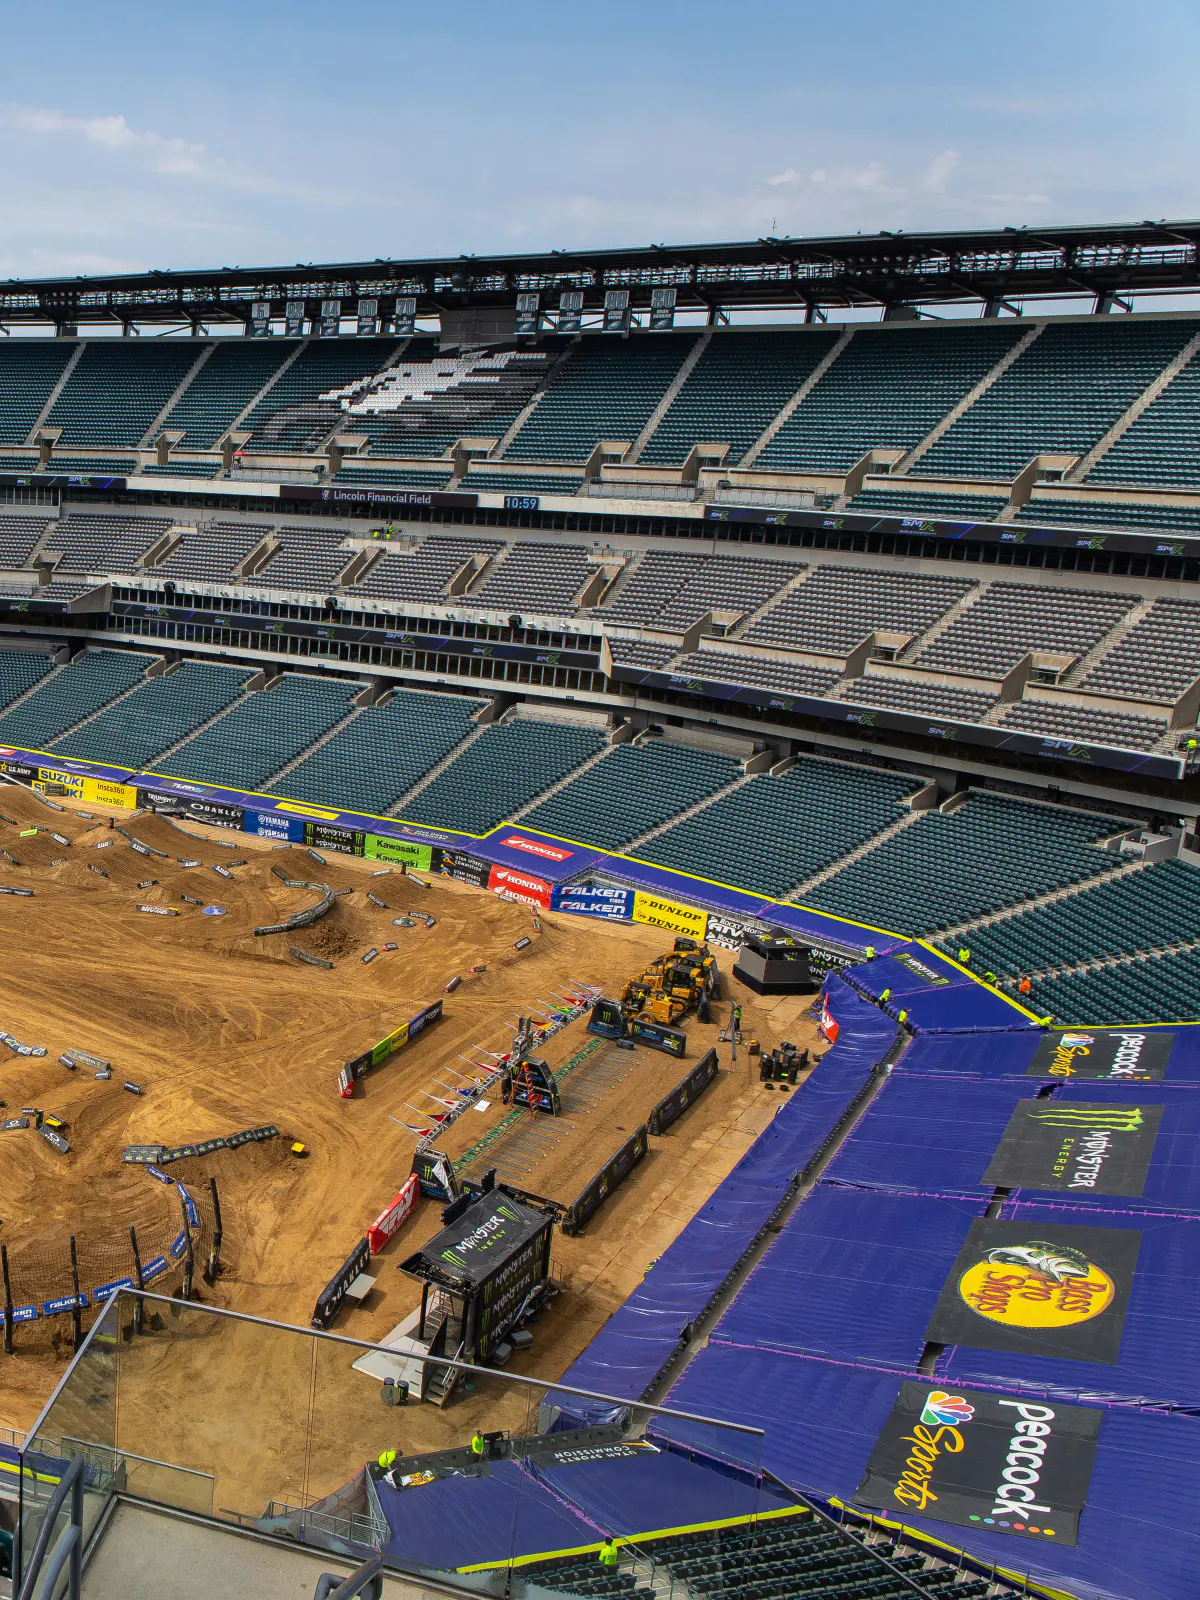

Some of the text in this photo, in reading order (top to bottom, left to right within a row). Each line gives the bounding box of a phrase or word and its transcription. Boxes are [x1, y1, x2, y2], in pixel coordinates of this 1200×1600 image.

[562, 293, 581, 309] 40
[607, 292, 628, 309] 99
[653, 290, 675, 308] 20
[333, 490, 432, 505] Lincoln Financial Field
[505, 496, 537, 510] 10:59
[41, 770, 85, 788] SUZUKI
[97, 783, 125, 795] Insta360
[96, 795, 124, 806] Insta360
[205, 806, 242, 818] OAKLEY
[265, 817, 289, 827] YAMAHA
[265, 829, 288, 839] YAMAHA
[316, 826, 352, 839] MONSTER
[377, 839, 419, 855] Kawasaki
[520, 841, 562, 859] HONDA
[507, 876, 543, 892] HONDA
[561, 886, 627, 898] FALKEN
[505, 889, 541, 907] HONDA
[560, 901, 626, 914] FALKEN
[649, 901, 702, 921] DUNLOP
[648, 916, 699, 937] DUNLOP
[720, 918, 742, 930] ROCKY
[812, 948, 852, 966] ONSTER
[907, 958, 939, 980] MONSTER
[1048, 1045, 1091, 1077] Sports
[1109, 1033, 1147, 1075] peacock
[1052, 1137, 1075, 1178] ENERGY
[1067, 1131, 1113, 1188] MONSTER
[456, 1215, 505, 1254] MONSTER
[495, 1247, 532, 1287] MONSTER
[493, 1273, 530, 1313] MONSTER
[968, 1271, 1025, 1314] Shops
[1019, 1274, 1064, 1302] Pro
[1056, 1277, 1108, 1314] Bass
[555, 1446, 631, 1458] COMMISSION
[559, 1450, 637, 1464] UTAH SPORTS
[991, 1399, 1056, 1521] peacock
[893, 1425, 965, 1510] Sports
